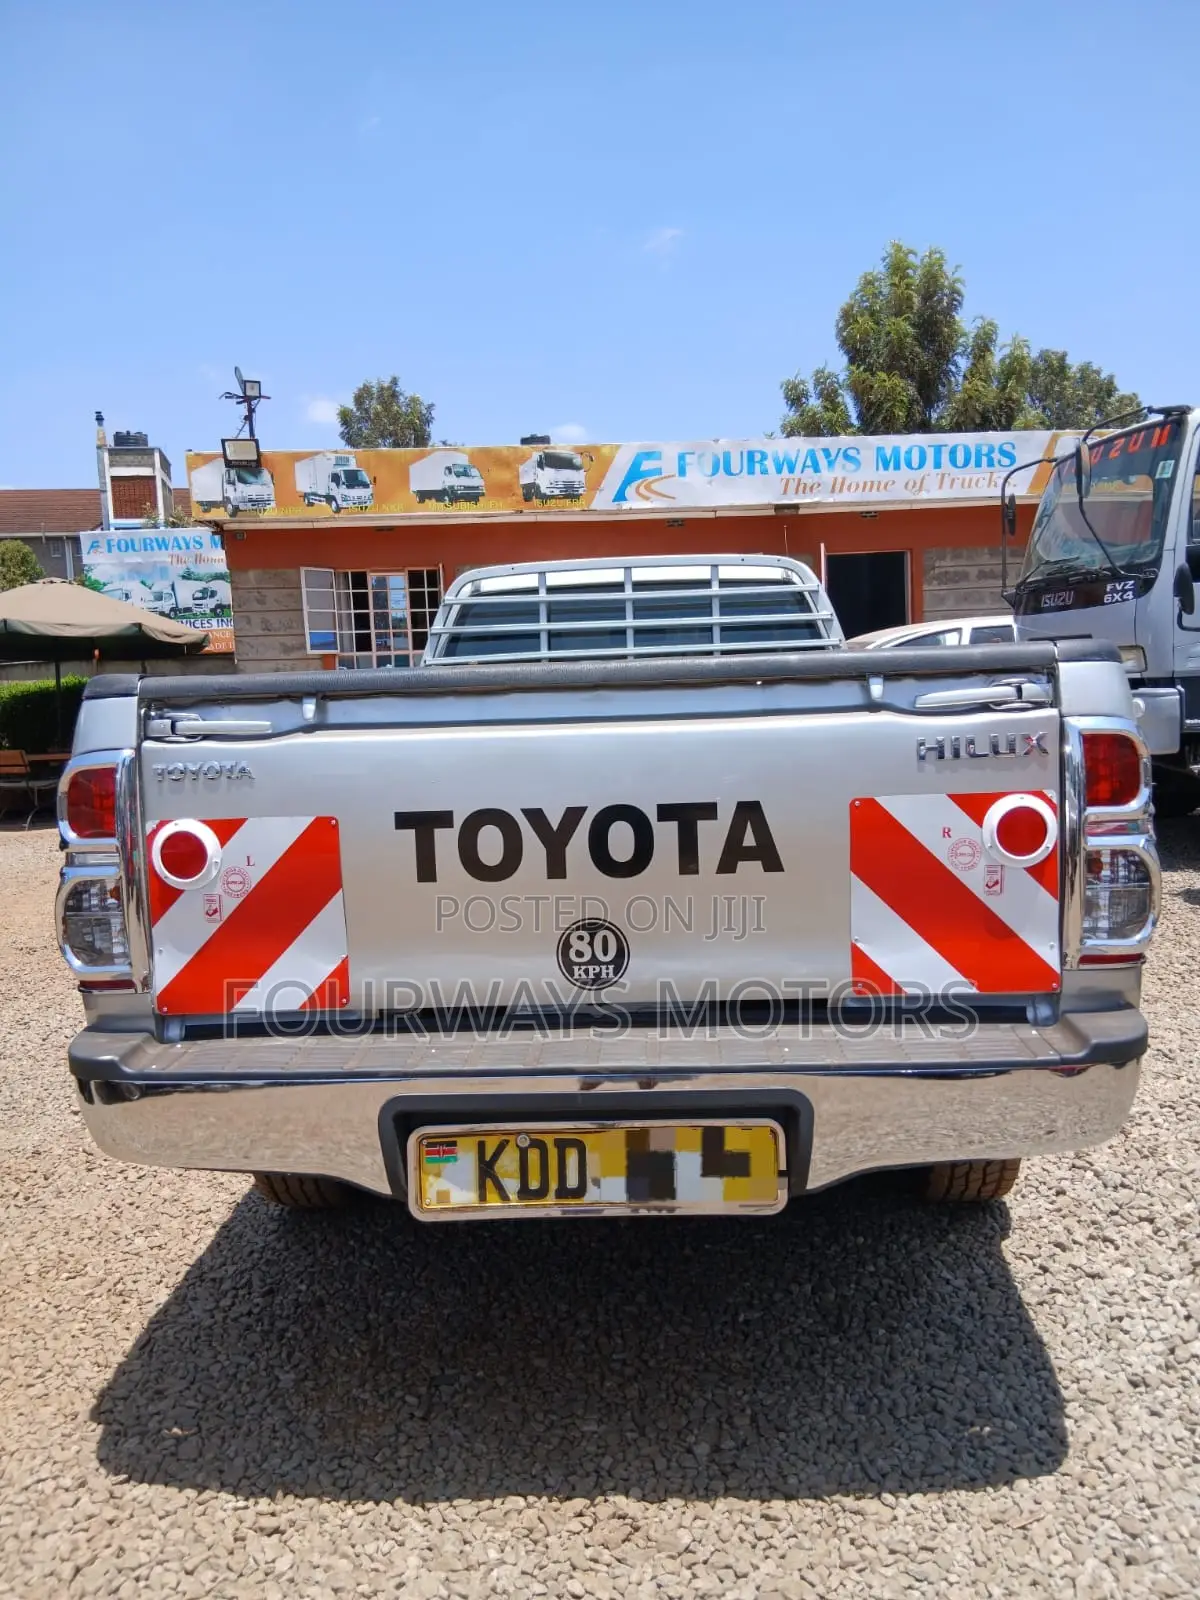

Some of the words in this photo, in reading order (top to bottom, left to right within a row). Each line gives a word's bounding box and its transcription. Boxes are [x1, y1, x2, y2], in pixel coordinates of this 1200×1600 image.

[677, 447, 861, 478] FOURWAYS
[875, 441, 1017, 472] MOTORS
[780, 477, 821, 496] The
[830, 476, 895, 494] Home
[903, 471, 929, 496] of
[106, 535, 204, 554] FOURWAYS
[1106, 580, 1135, 592] FVZ
[1040, 590, 1074, 608] ISUZU
[1104, 591, 1135, 604] 6X4
[917, 732, 1049, 761] HILUX
[151, 760, 256, 782] TOYOTA
[394, 800, 786, 883] TOYOTA
[942, 827, 952, 838] R
[246, 856, 255, 867] L
[569, 929, 617, 963] 80
[572, 965, 615, 979] KPH
[477, 1138, 588, 1202] KDD
